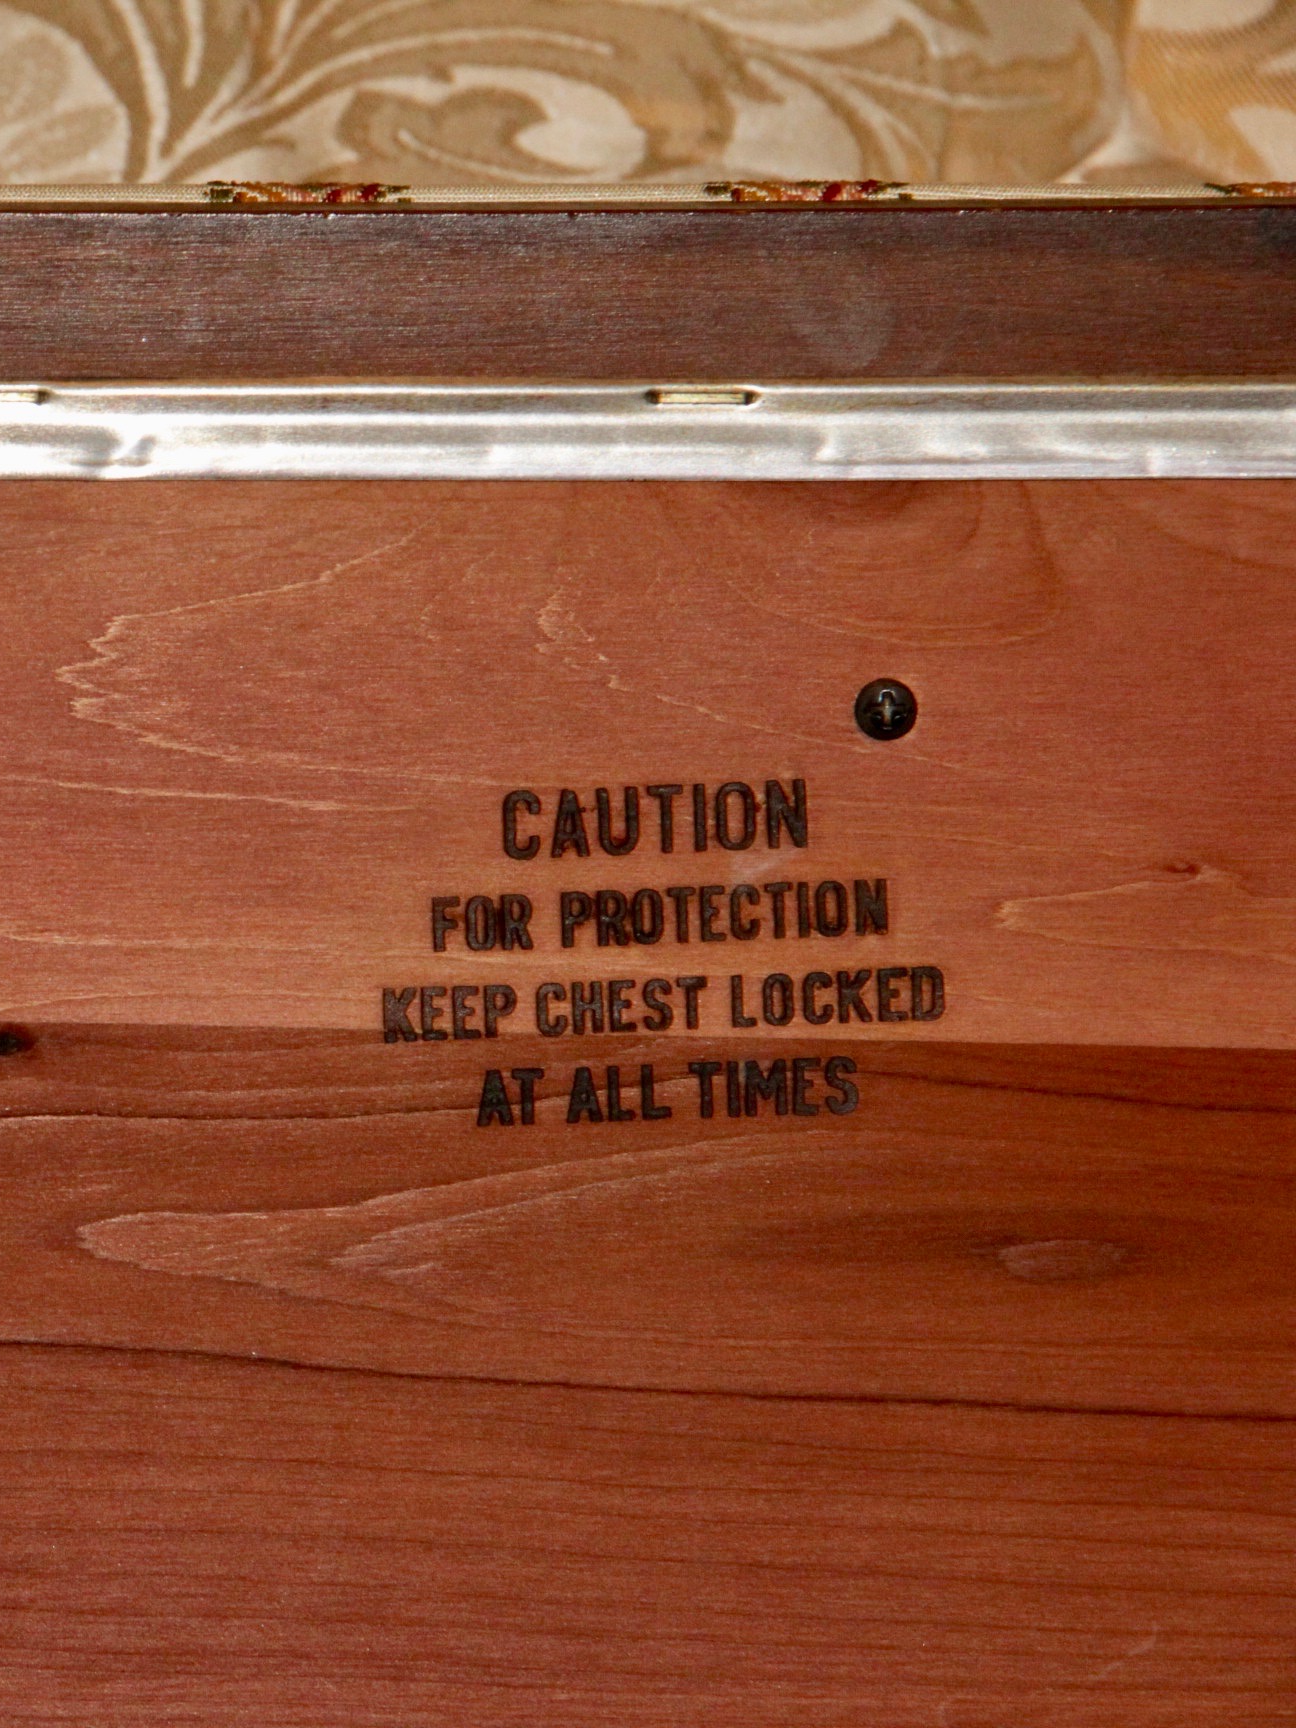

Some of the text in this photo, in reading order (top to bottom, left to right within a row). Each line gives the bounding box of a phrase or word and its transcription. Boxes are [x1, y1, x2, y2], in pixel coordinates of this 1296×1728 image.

[503, 778, 809, 861] CAUTION
[431, 878, 889, 953] FOR PROTECTION
[382, 965, 946, 1044] KEEP CHEST LOCKED
[477, 1056, 860, 1127] AT ALL TIMES
